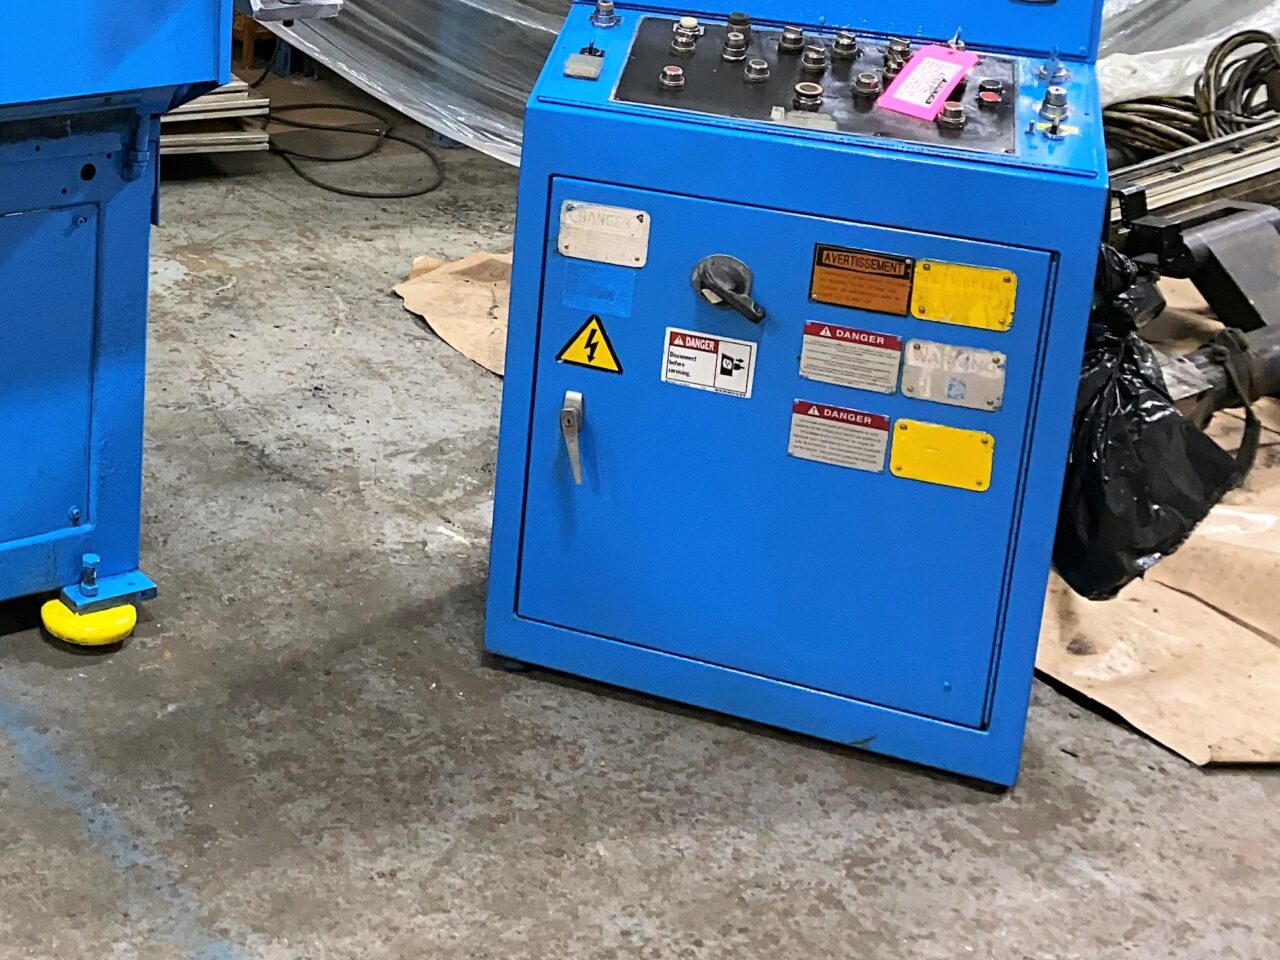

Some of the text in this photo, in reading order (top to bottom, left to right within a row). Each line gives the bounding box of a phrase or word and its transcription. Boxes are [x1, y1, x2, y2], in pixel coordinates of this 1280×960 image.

[824, 252, 903, 274] AVERTISSEMENT
[685, 336, 715, 352] DANGER
[835, 329, 885, 345] DANGER
[669, 351, 697, 362] Disconnect
[669, 360, 685, 368] before
[823, 408, 872, 425] DANGER
